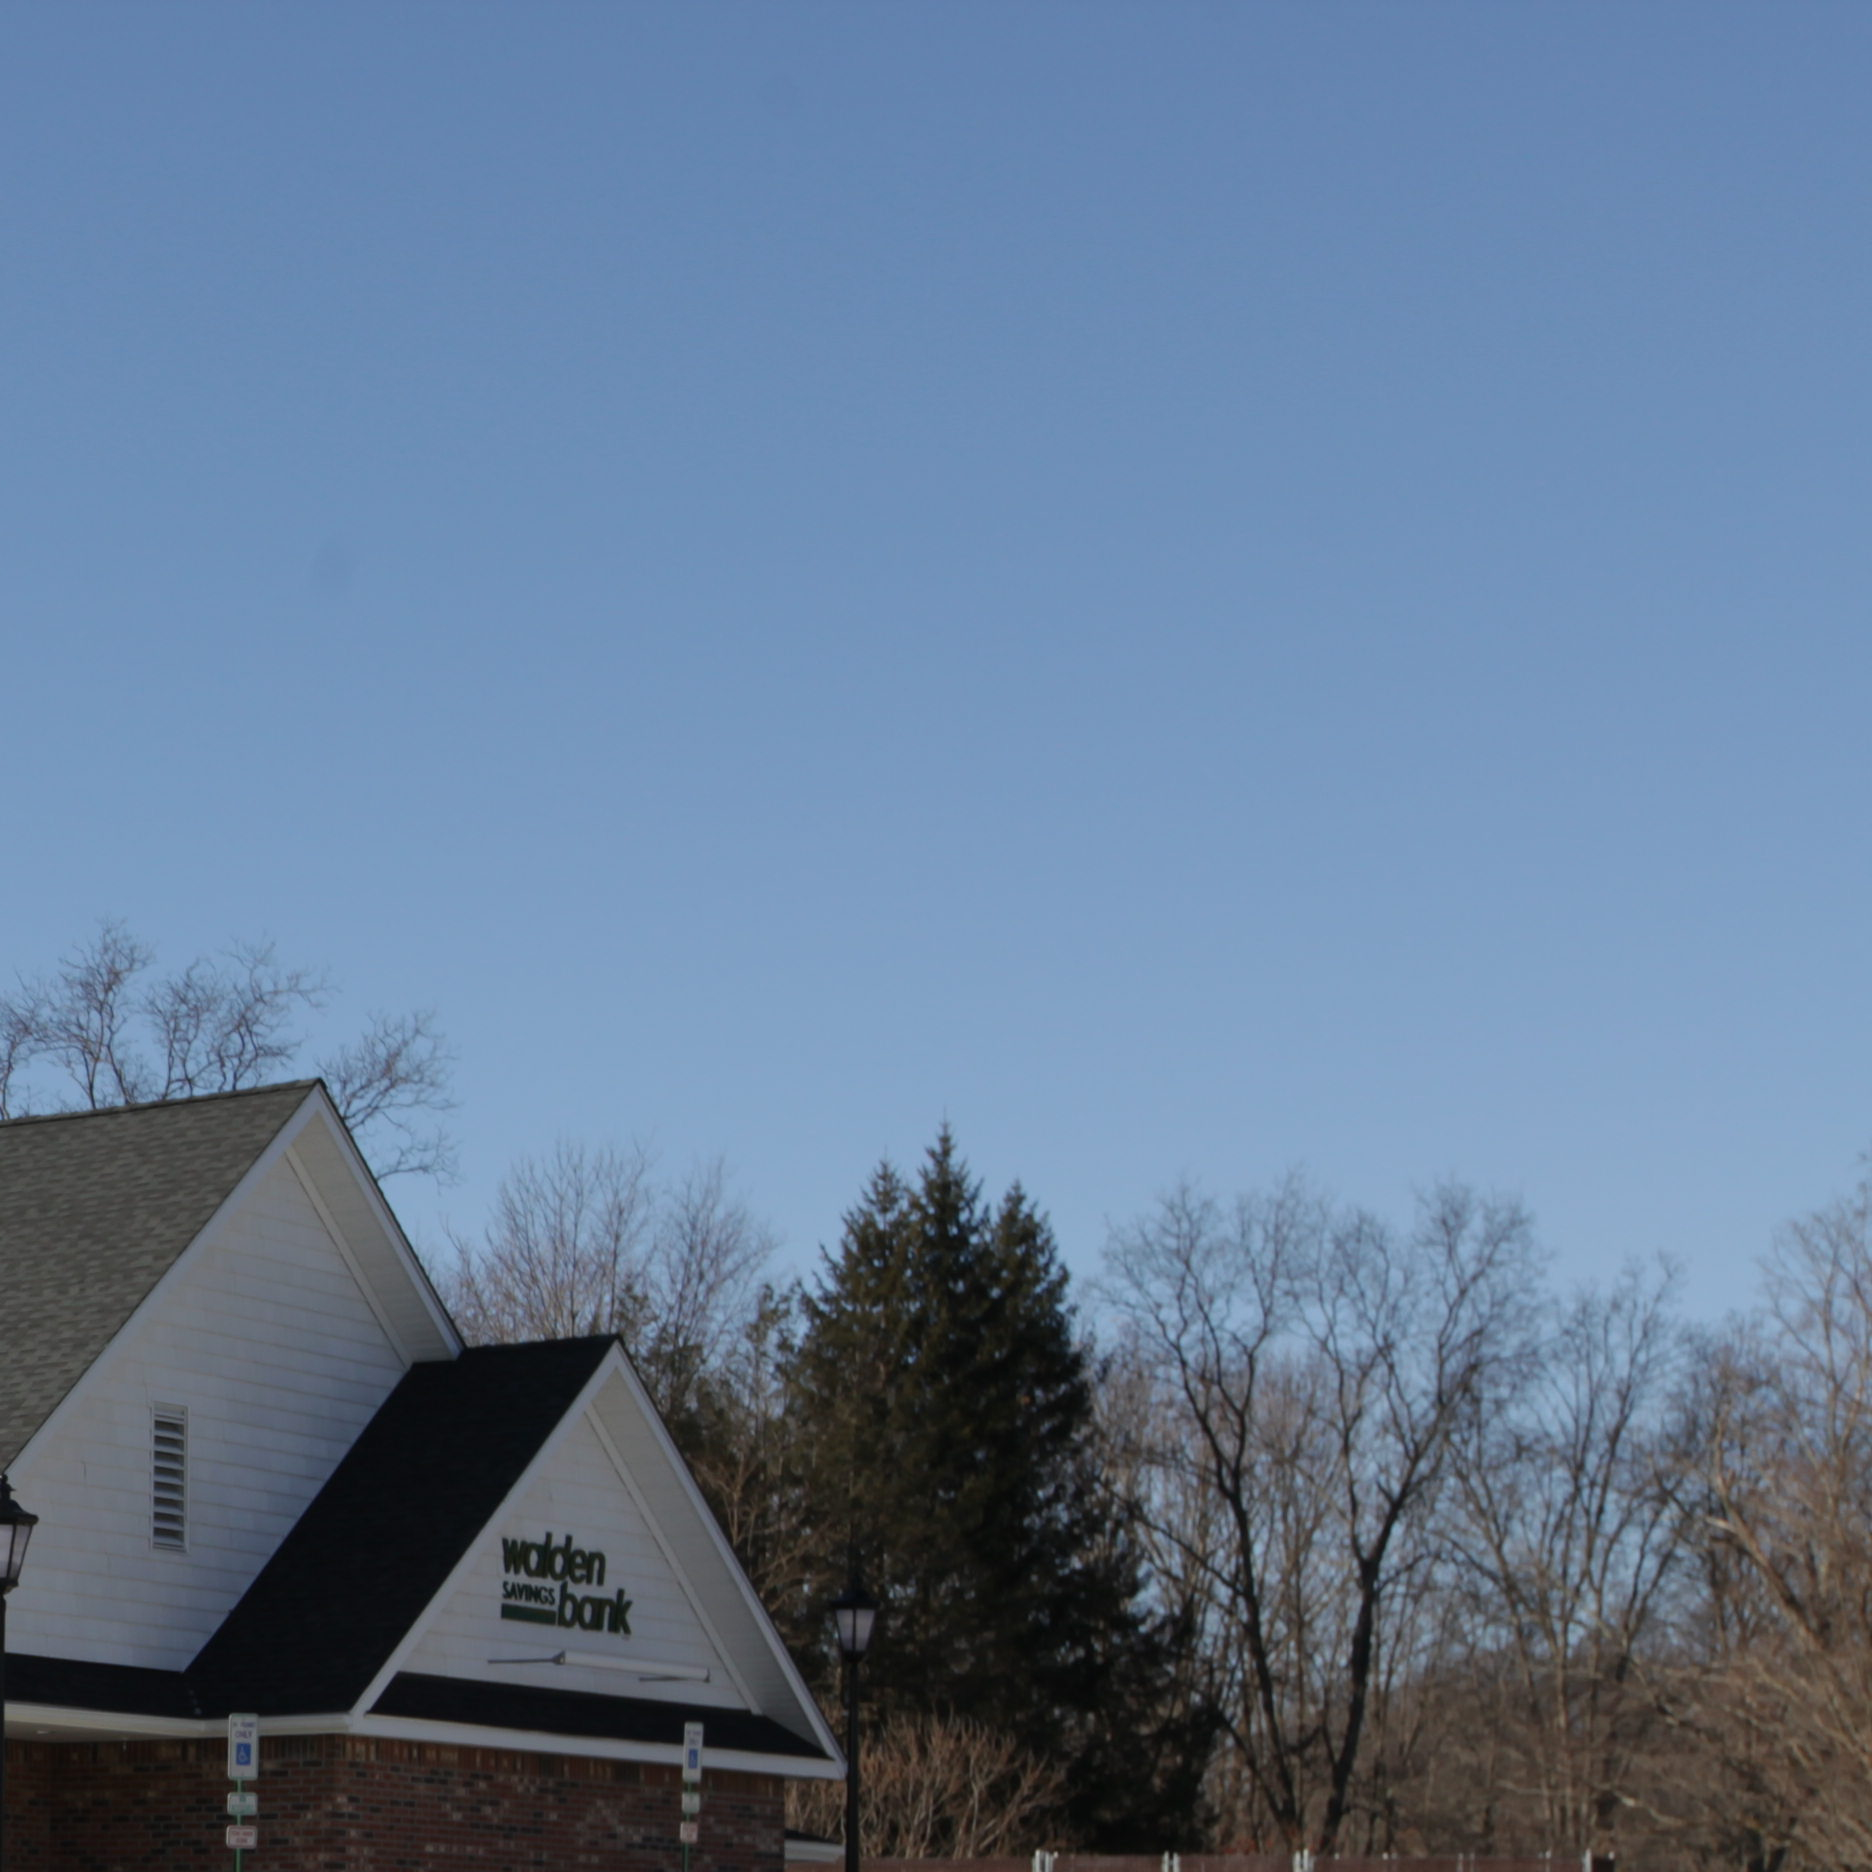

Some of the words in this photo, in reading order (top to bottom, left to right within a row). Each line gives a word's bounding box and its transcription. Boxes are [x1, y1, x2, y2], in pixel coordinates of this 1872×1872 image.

[502, 1531, 606, 1586] walden
[502, 1580, 555, 1606] SAVINGS
[558, 1581, 633, 1635] bank
